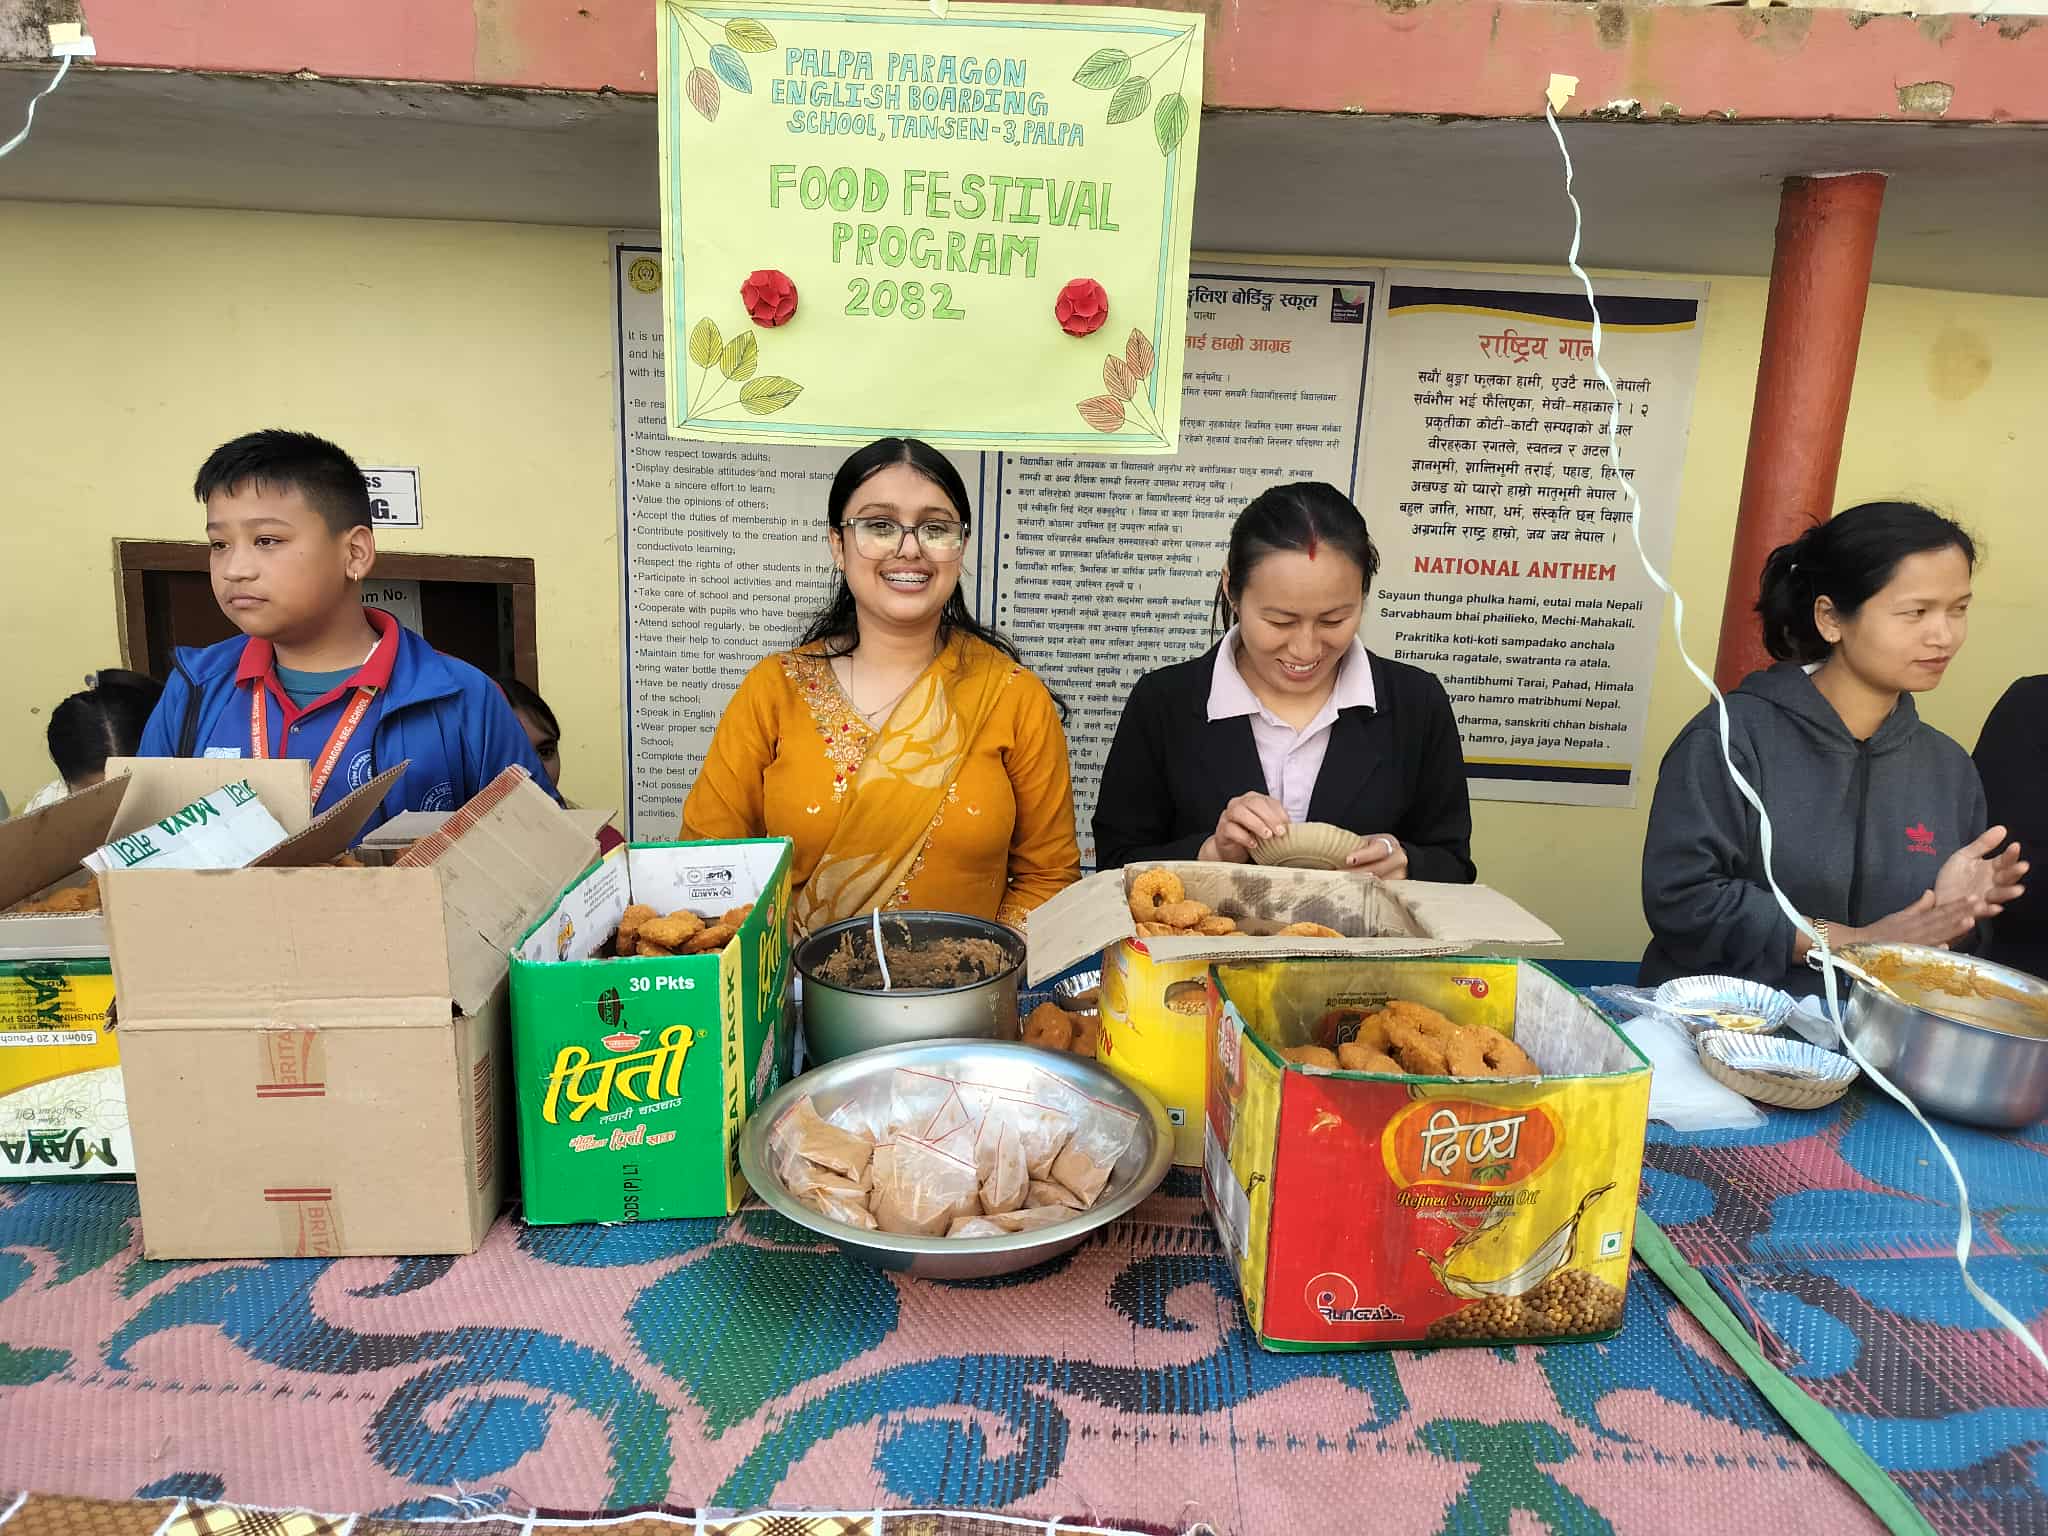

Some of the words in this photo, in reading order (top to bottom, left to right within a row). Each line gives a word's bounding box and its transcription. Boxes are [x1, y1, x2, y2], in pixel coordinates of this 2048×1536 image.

[785, 47, 873, 81] PALPA
[887, 52, 1026, 87] PARAGON
[771, 79, 901, 111] ENGLISH
[908, 85, 1049, 117] BOARDING
[769, 164, 890, 213] FOOD
[903, 170, 1120, 232] FESTIVAL
[832, 222, 1040, 278] PROGRAM
[845, 277, 965, 321] 2082
[635, 446, 661, 457] Show
[664, 450, 698, 459] respect
[701, 449, 737, 460] towards
[740, 451, 771, 463] adults;
[636, 462, 670, 475] Display
[673, 464, 714, 475] desirable
[718, 466, 756, 478] attitudes
[759, 469, 777, 478] and
[780, 470, 806, 480] moral
[637, 494, 663, 504] Value
[666, 496, 681, 505] the
[684, 496, 722, 508] opinions
[725, 498, 735, 508] of
[737, 499, 769, 510] others;
[1414, 557, 1519, 577] NATIONAL
[1527, 561, 1616, 581] ANTHEM
[383, 589, 407, 601] No.
[638, 587, 661, 597] Take
[664, 590, 684, 598] care
[687, 589, 696, 599] of
[700, 591, 729, 600] school
[732, 592, 749, 601] and
[752, 594, 790, 604] personal
[1378, 589, 1420, 603] Sayaun
[1424, 592, 1463, 605] thunga
[1466, 593, 1505, 606] phulka
[1508, 595, 1539, 608] hami,
[1543, 597, 1572, 608] eutai
[1574, 599, 1603, 609] mala
[1606, 599, 1643, 612] Nepali
[1380, 608, 1452, 621] Sarvabhaum
[1455, 611, 1480, 622] bhai
[1482, 612, 1538, 626] phailieko,
[1542, 615, 1635, 629] Mechi-Mahakali.
[639, 633, 663, 642] Have
[666, 634, 686, 645] their
[689, 634, 708, 646] help
[711, 637, 720, 645] to
[723, 638, 758, 646] conduct
[1395, 631, 1449, 644] Prakritika
[1453, 634, 1498, 646] koti-koti
[1501, 638, 1567, 649] sampadako
[1570, 640, 1615, 651] anchala
[1394, 649, 1449, 661] Birharuka
[1452, 653, 1502, 665] ragatale,
[1505, 656, 1561, 666] swatranta
[1564, 659, 1576, 667] ra
[1579, 658, 1610, 669] atala.
[1443, 676, 1514, 688] shantibhumi
[1516, 677, 1548, 690] Tarai,
[1552, 679, 1591, 692] Pahad,
[1594, 681, 1634, 692] Himala
[1478, 693, 1515, 704] hamro
[1518, 696, 1582, 708] matribhumi
[1585, 698, 1620, 711] Nepal.
[1457, 716, 1502, 729] dharma,
[1504, 718, 1550, 728] sanskriti
[1552, 719, 1586, 730] chhan
[1588, 720, 1627, 732] bishala
[1468, 732, 1507, 745] hamro,
[1510, 735, 1534, 747] jaya
[1536, 736, 1561, 748] jaya
[1564, 737, 1604, 750] Nepala
[638, 810, 678, 820] activities.
[630, 977, 651, 991] 30
[655, 976, 696, 990] Pkts
[727, 968, 737, 1067] PACK
[542, 1024, 694, 1124] प्रिती
[1396, 1191, 1449, 1208] Refined
